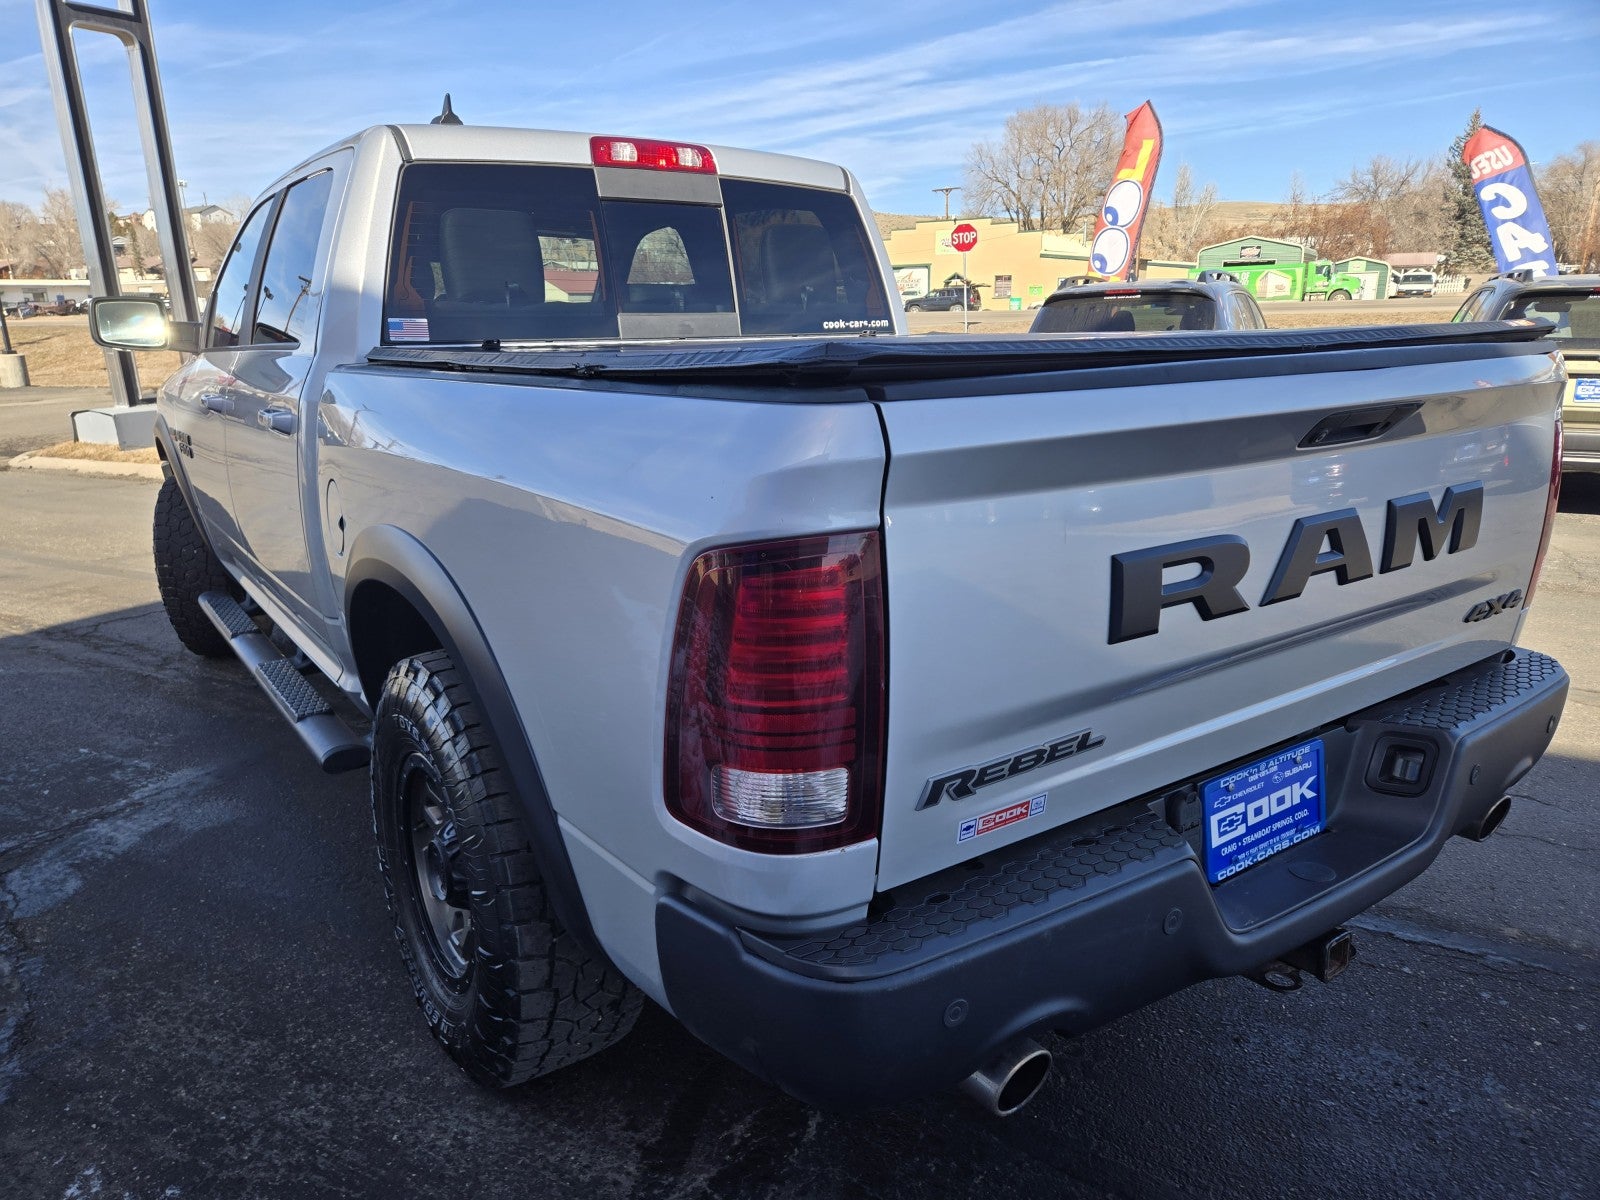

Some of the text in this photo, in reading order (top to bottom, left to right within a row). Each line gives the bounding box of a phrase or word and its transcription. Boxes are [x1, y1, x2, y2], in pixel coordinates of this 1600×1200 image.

[952, 231, 977, 245] STOP
[823, 319, 889, 329] cook-cars.com
[1108, 480, 1484, 645] RAM
[914, 727, 1107, 811] REBEL
[1268, 745, 1311, 768] ALTITUDE
[1284, 760, 1313, 778] SUBARU
[1232, 781, 1265, 800] CHEVROLET
[978, 804, 1028, 830] COOK
[1210, 775, 1317, 848] COOK
[1217, 825, 1321, 881] COOK-CARS.COM
[1221, 842, 1237, 857] CRAIG
[1242, 825, 1272, 846] STEAMBOAT
